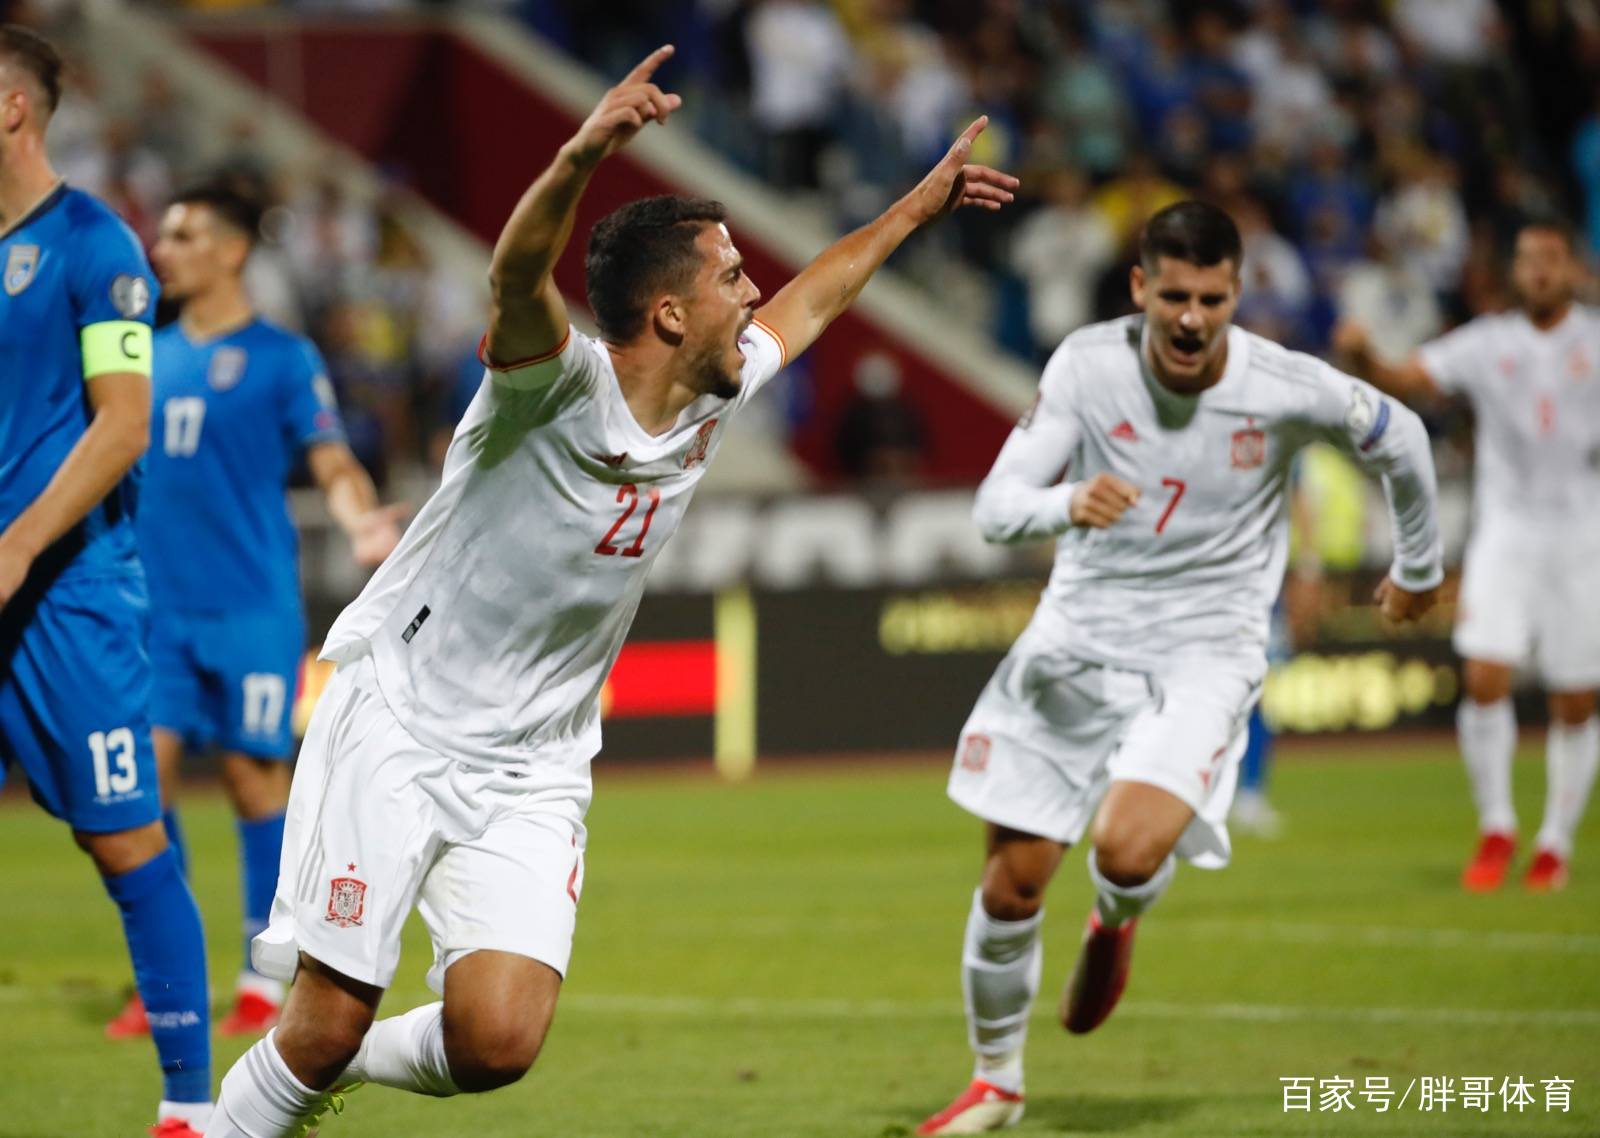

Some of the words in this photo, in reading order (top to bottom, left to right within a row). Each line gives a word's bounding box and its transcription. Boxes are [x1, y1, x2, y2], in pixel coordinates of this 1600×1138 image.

[120, 330, 140, 359] C
[164, 397, 206, 457] 17
[594, 482, 661, 557] 21
[1156, 477, 1186, 534] 7
[242, 673, 286, 734] 17
[88, 727, 137, 796] 13
